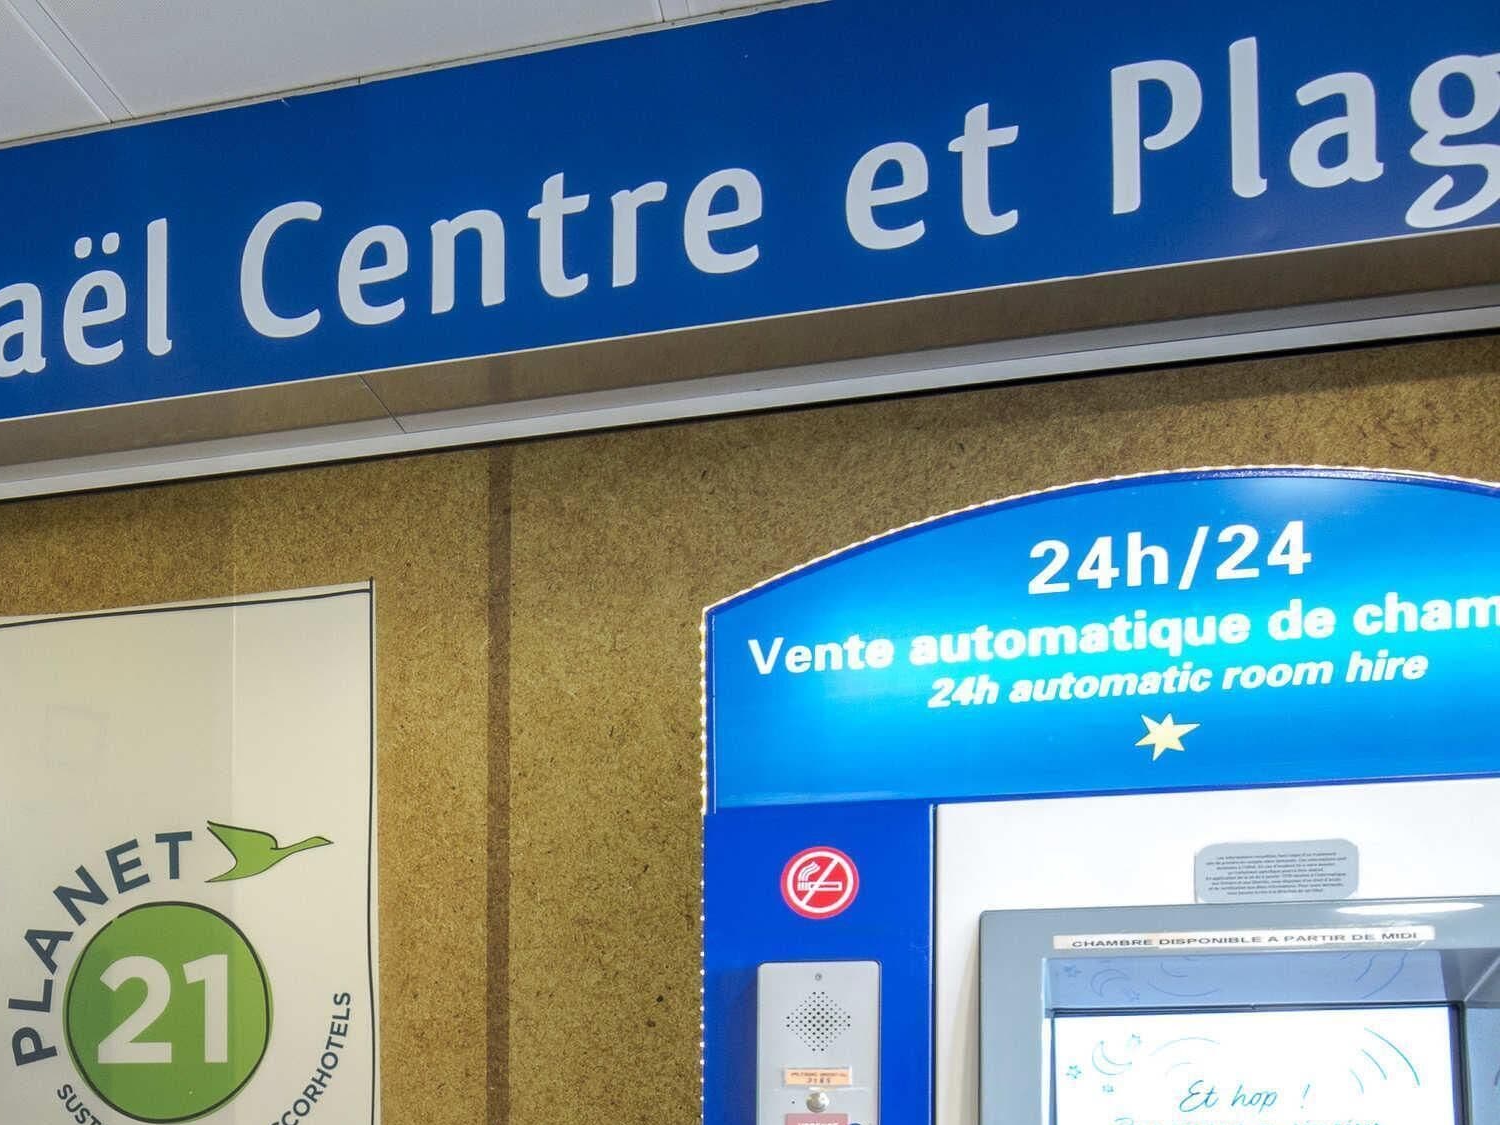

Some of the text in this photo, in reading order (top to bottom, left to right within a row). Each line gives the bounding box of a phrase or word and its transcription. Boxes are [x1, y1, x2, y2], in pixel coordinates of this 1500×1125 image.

[240, 168, 763, 338] Centre
[845, 102, 1019, 251] et
[1110, 36, 1500, 230] Plag
[1028, 520, 1313, 596] 24h/24
[748, 591, 1500, 675] Vente automatique de cham
[927, 649, 1428, 708] 24h automatic room hire
[8, 831, 192, 1066] PLANET
[1072, 938, 1153, 948] CHAMBRE
[1159, 936, 1261, 945] DISPONIBLE
[1284, 934, 1345, 942] PARTIR
[1352, 933, 1375, 941] DE
[1381, 932, 1417, 940] MIDI
[98, 954, 229, 1064] 21
[1179, 1079, 1310, 1114] Et hop !
